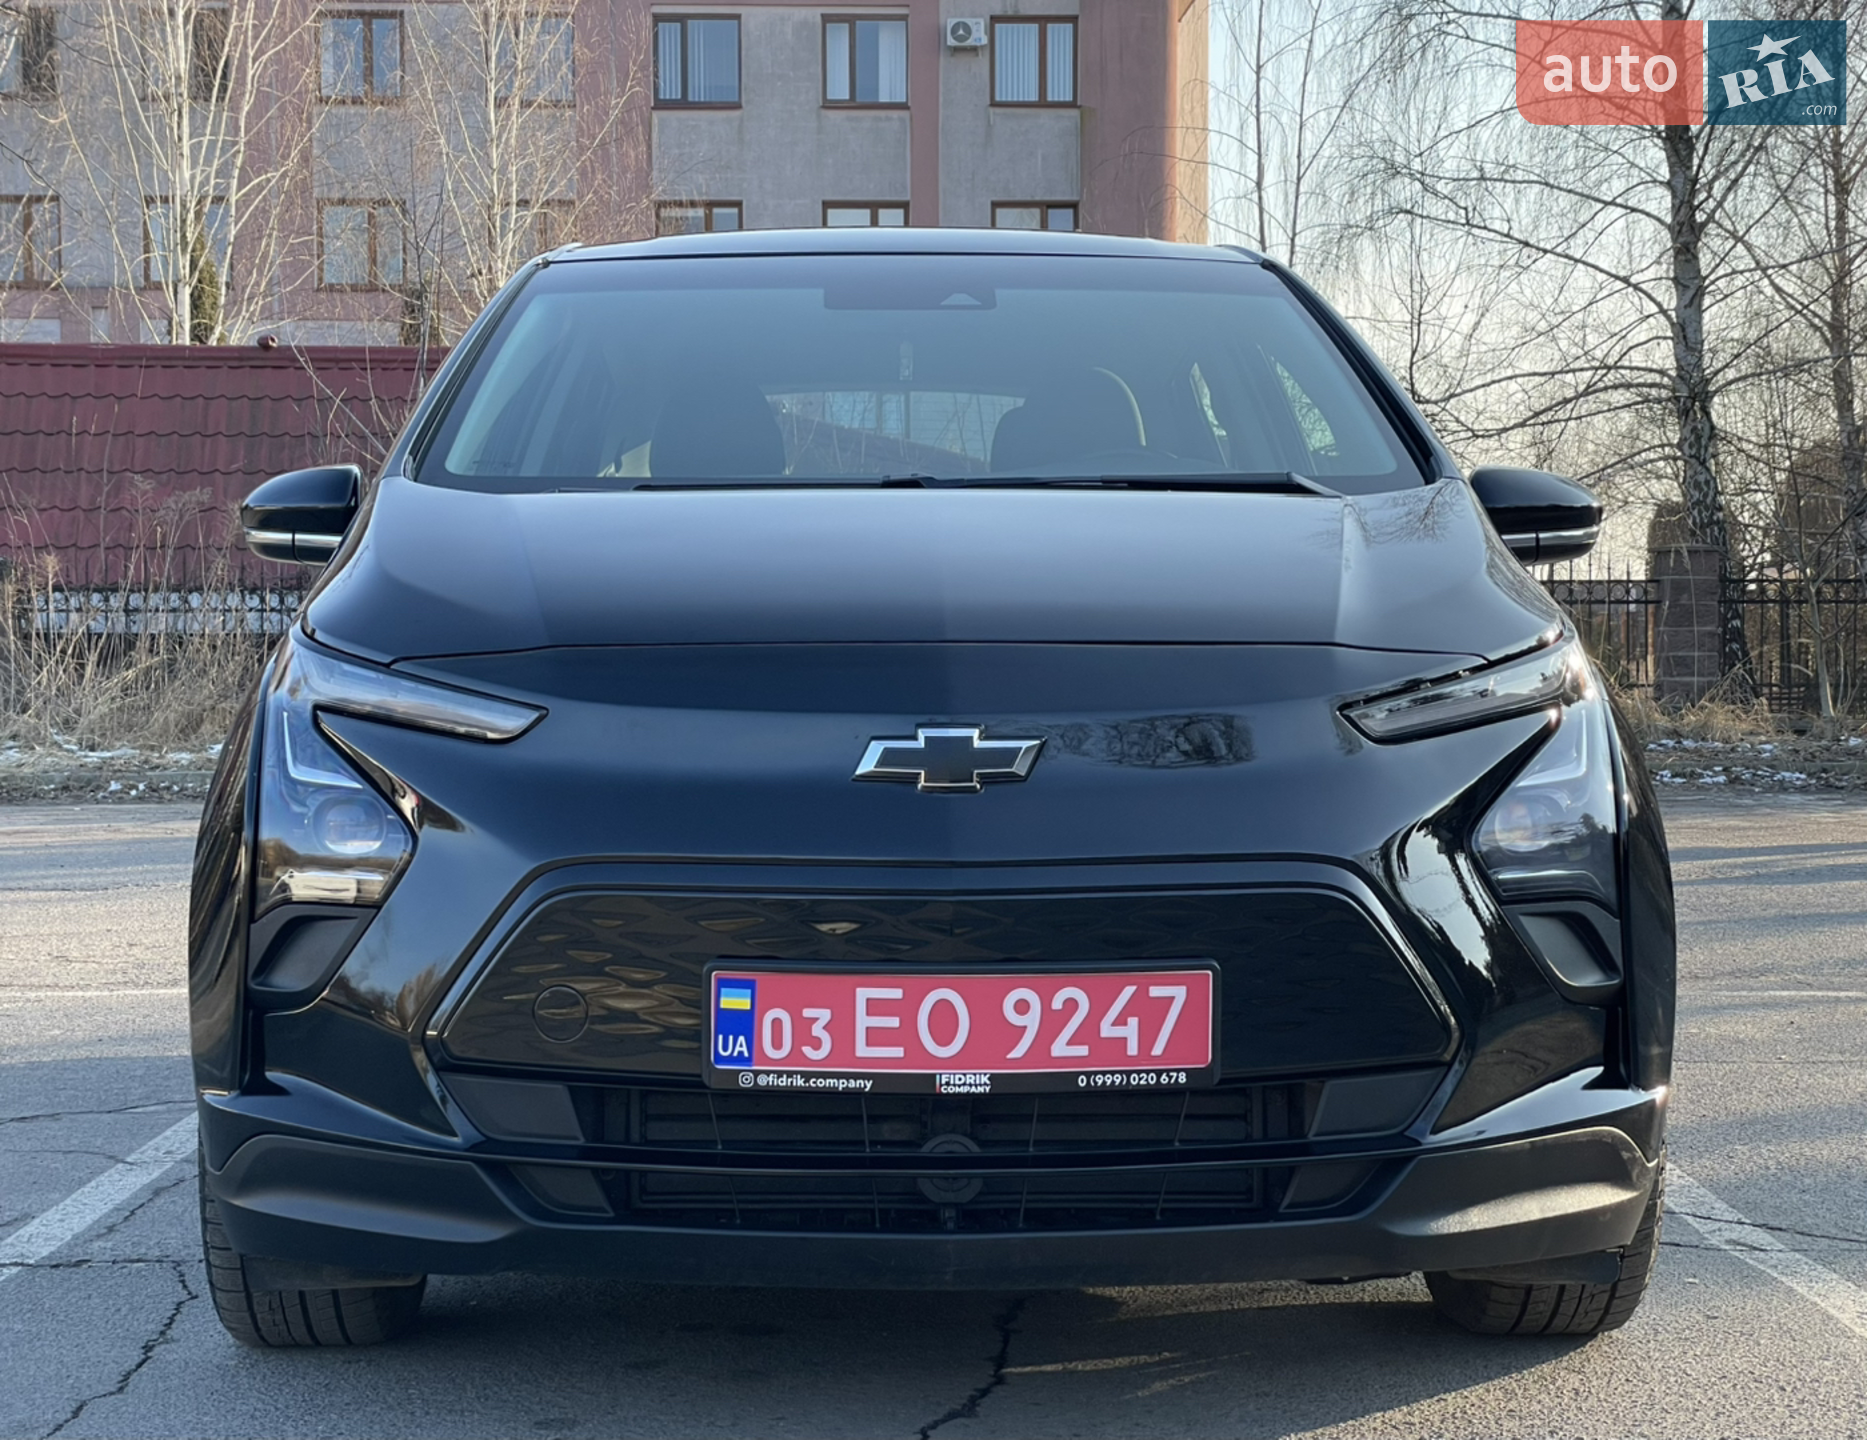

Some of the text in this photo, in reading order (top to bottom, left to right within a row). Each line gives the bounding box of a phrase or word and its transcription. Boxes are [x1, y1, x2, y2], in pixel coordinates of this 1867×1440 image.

[762, 985, 1188, 1061] 03 EO 9247
[717, 1034, 749, 1058] UA
[756, 1073, 874, 1092] @fidrik.company
[941, 1073, 991, 1085] FIDRIK
[1077, 1071, 1187, 1088] 0 (999) 020 678
[940, 1085, 991, 1094] COMPANY
